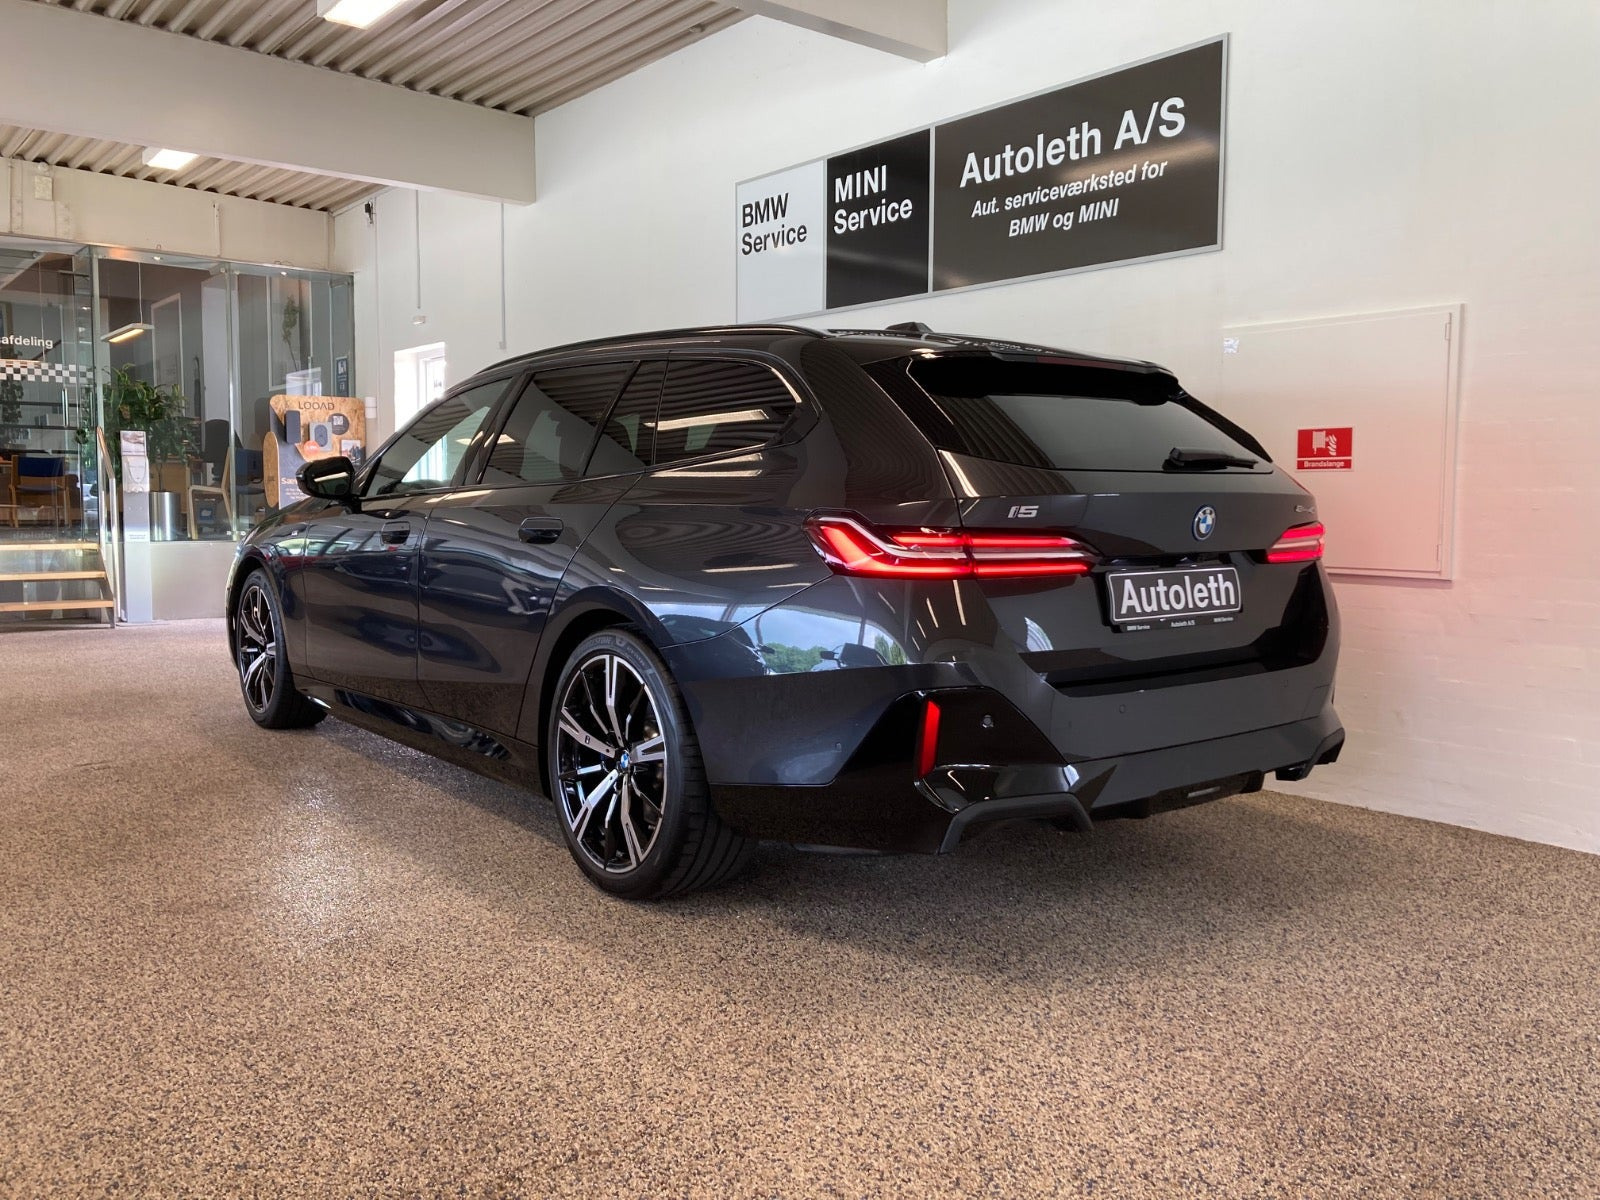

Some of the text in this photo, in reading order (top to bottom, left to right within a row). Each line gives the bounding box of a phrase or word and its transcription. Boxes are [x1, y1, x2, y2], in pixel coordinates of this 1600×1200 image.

[960, 97, 1187, 188] Autoleth A/S
[835, 164, 887, 204] MINI
[971, 160, 1169, 219] Aut. serviceværksted for
[742, 193, 790, 229] BMW
[833, 198, 913, 236] Service
[1008, 198, 1120, 238] BMW og MINI
[741, 223, 808, 256] Service
[0, 335, 54, 349] afdeling
[298, 401, 335, 411] LOOAD
[1303, 460, 1345, 468] Brandslange
[1120, 573, 1237, 615] Autoleth
